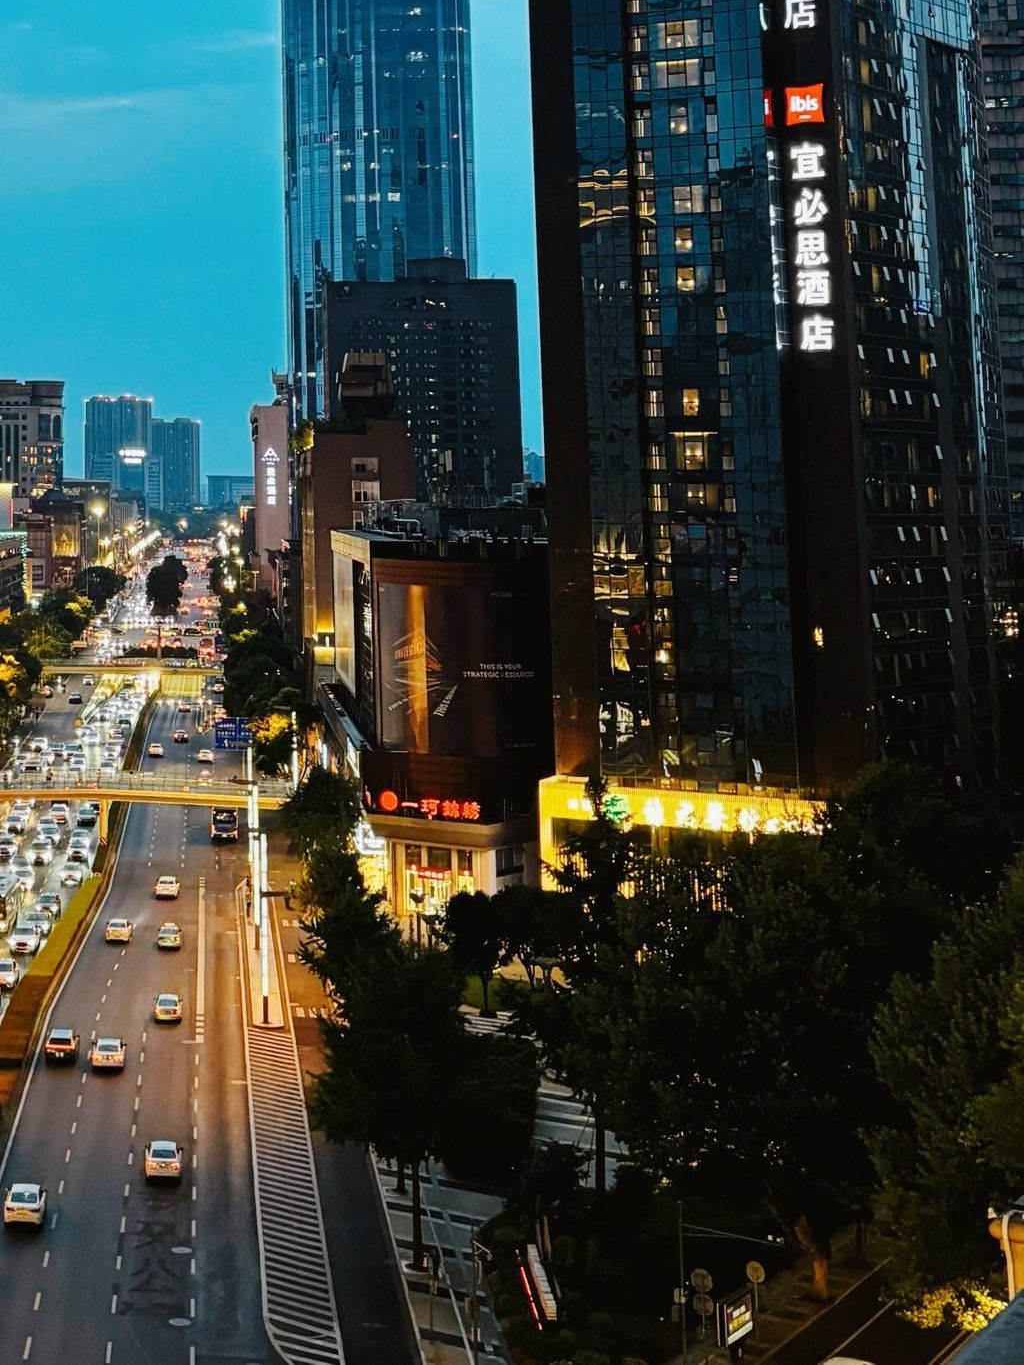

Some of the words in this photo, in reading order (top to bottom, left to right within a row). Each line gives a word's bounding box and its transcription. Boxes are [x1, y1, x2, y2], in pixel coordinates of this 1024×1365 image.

[790, 95, 819, 113] ibis
[789, 141, 834, 352] 宜必思酒店
